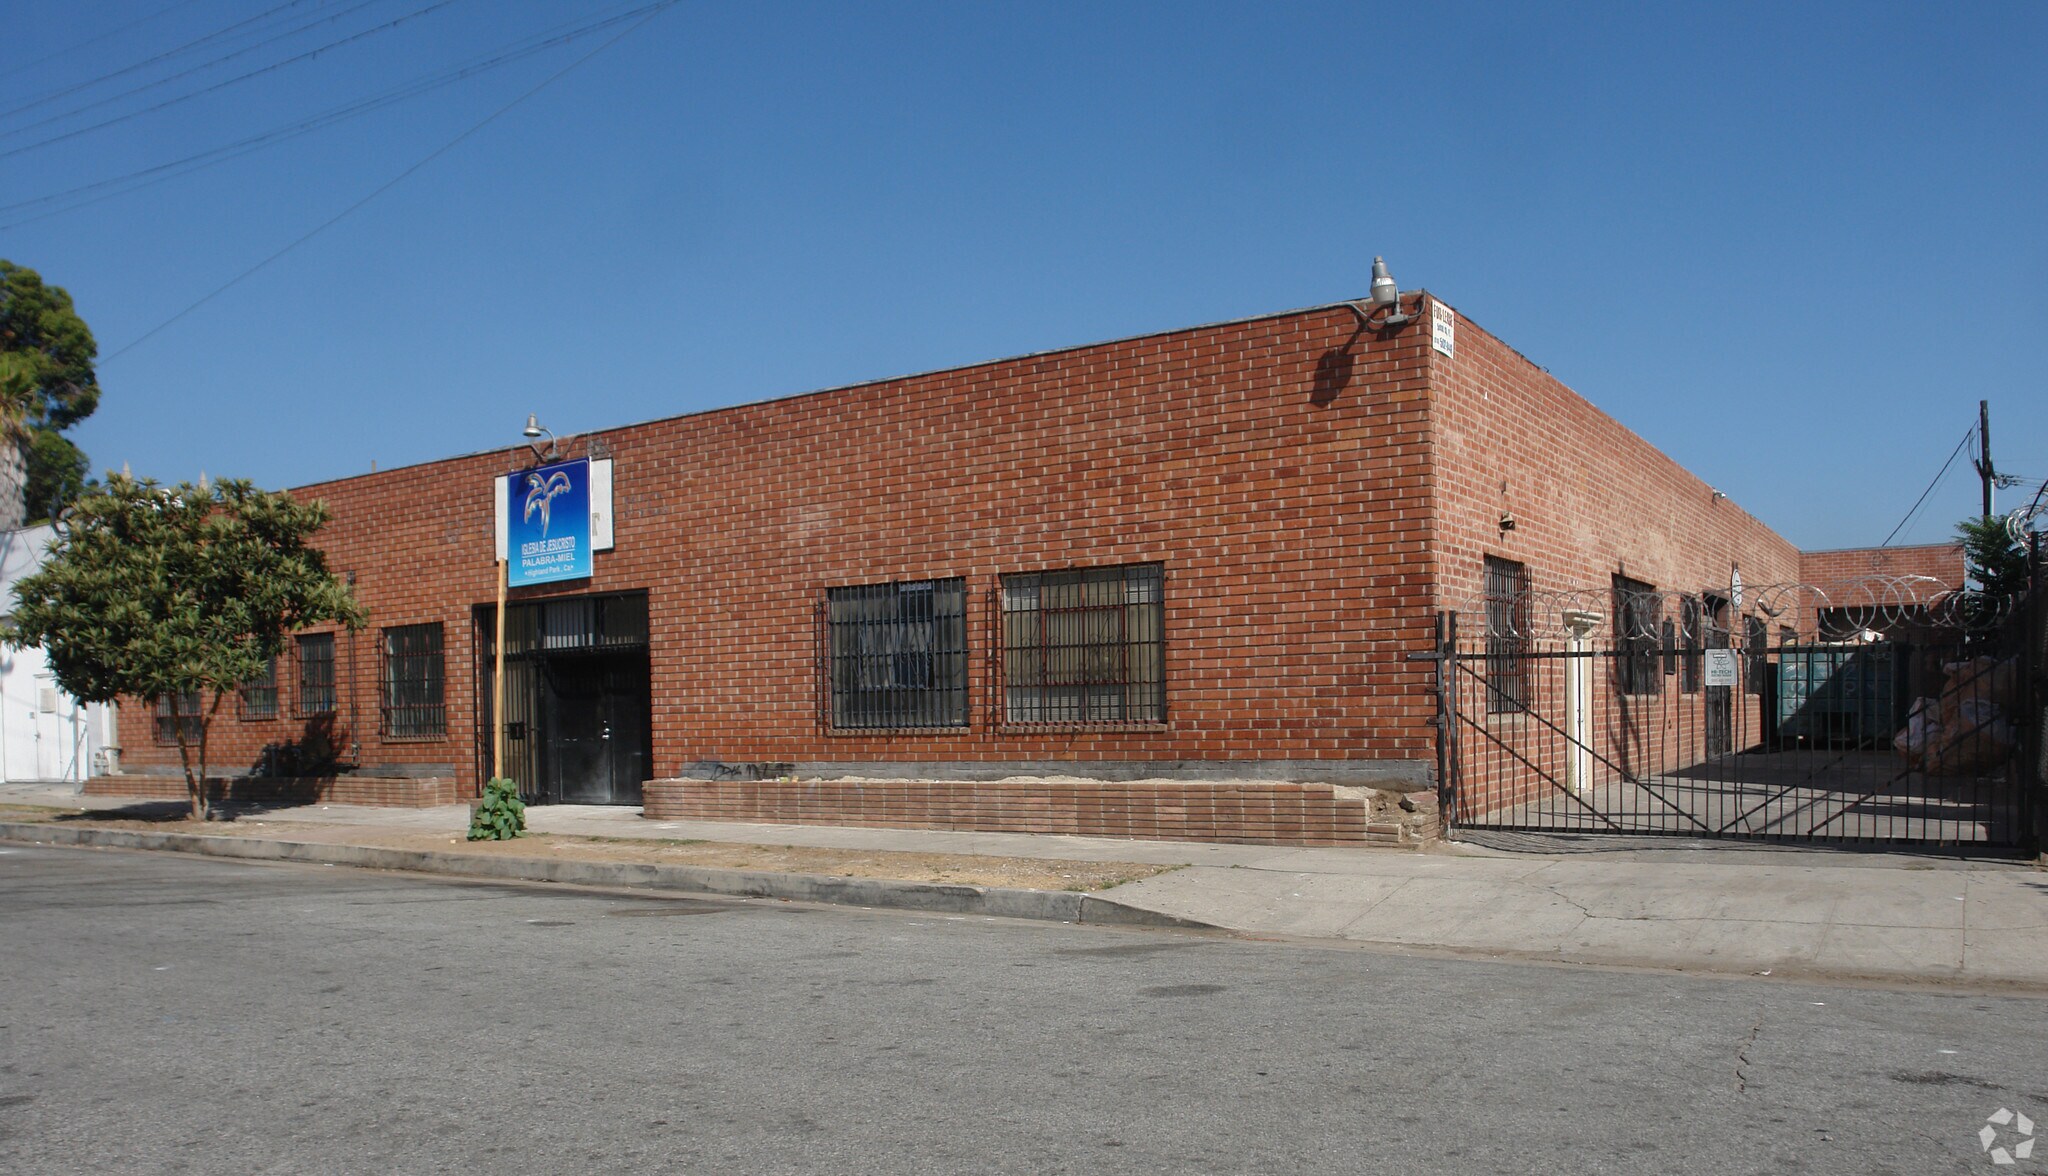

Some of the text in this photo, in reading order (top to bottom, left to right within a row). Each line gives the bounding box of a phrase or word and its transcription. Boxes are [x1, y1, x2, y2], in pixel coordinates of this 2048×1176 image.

[521, 536, 575, 555] IGLESIA DE JESUCRISTO
[522, 553, 575, 567] PALABRA-MIEL
